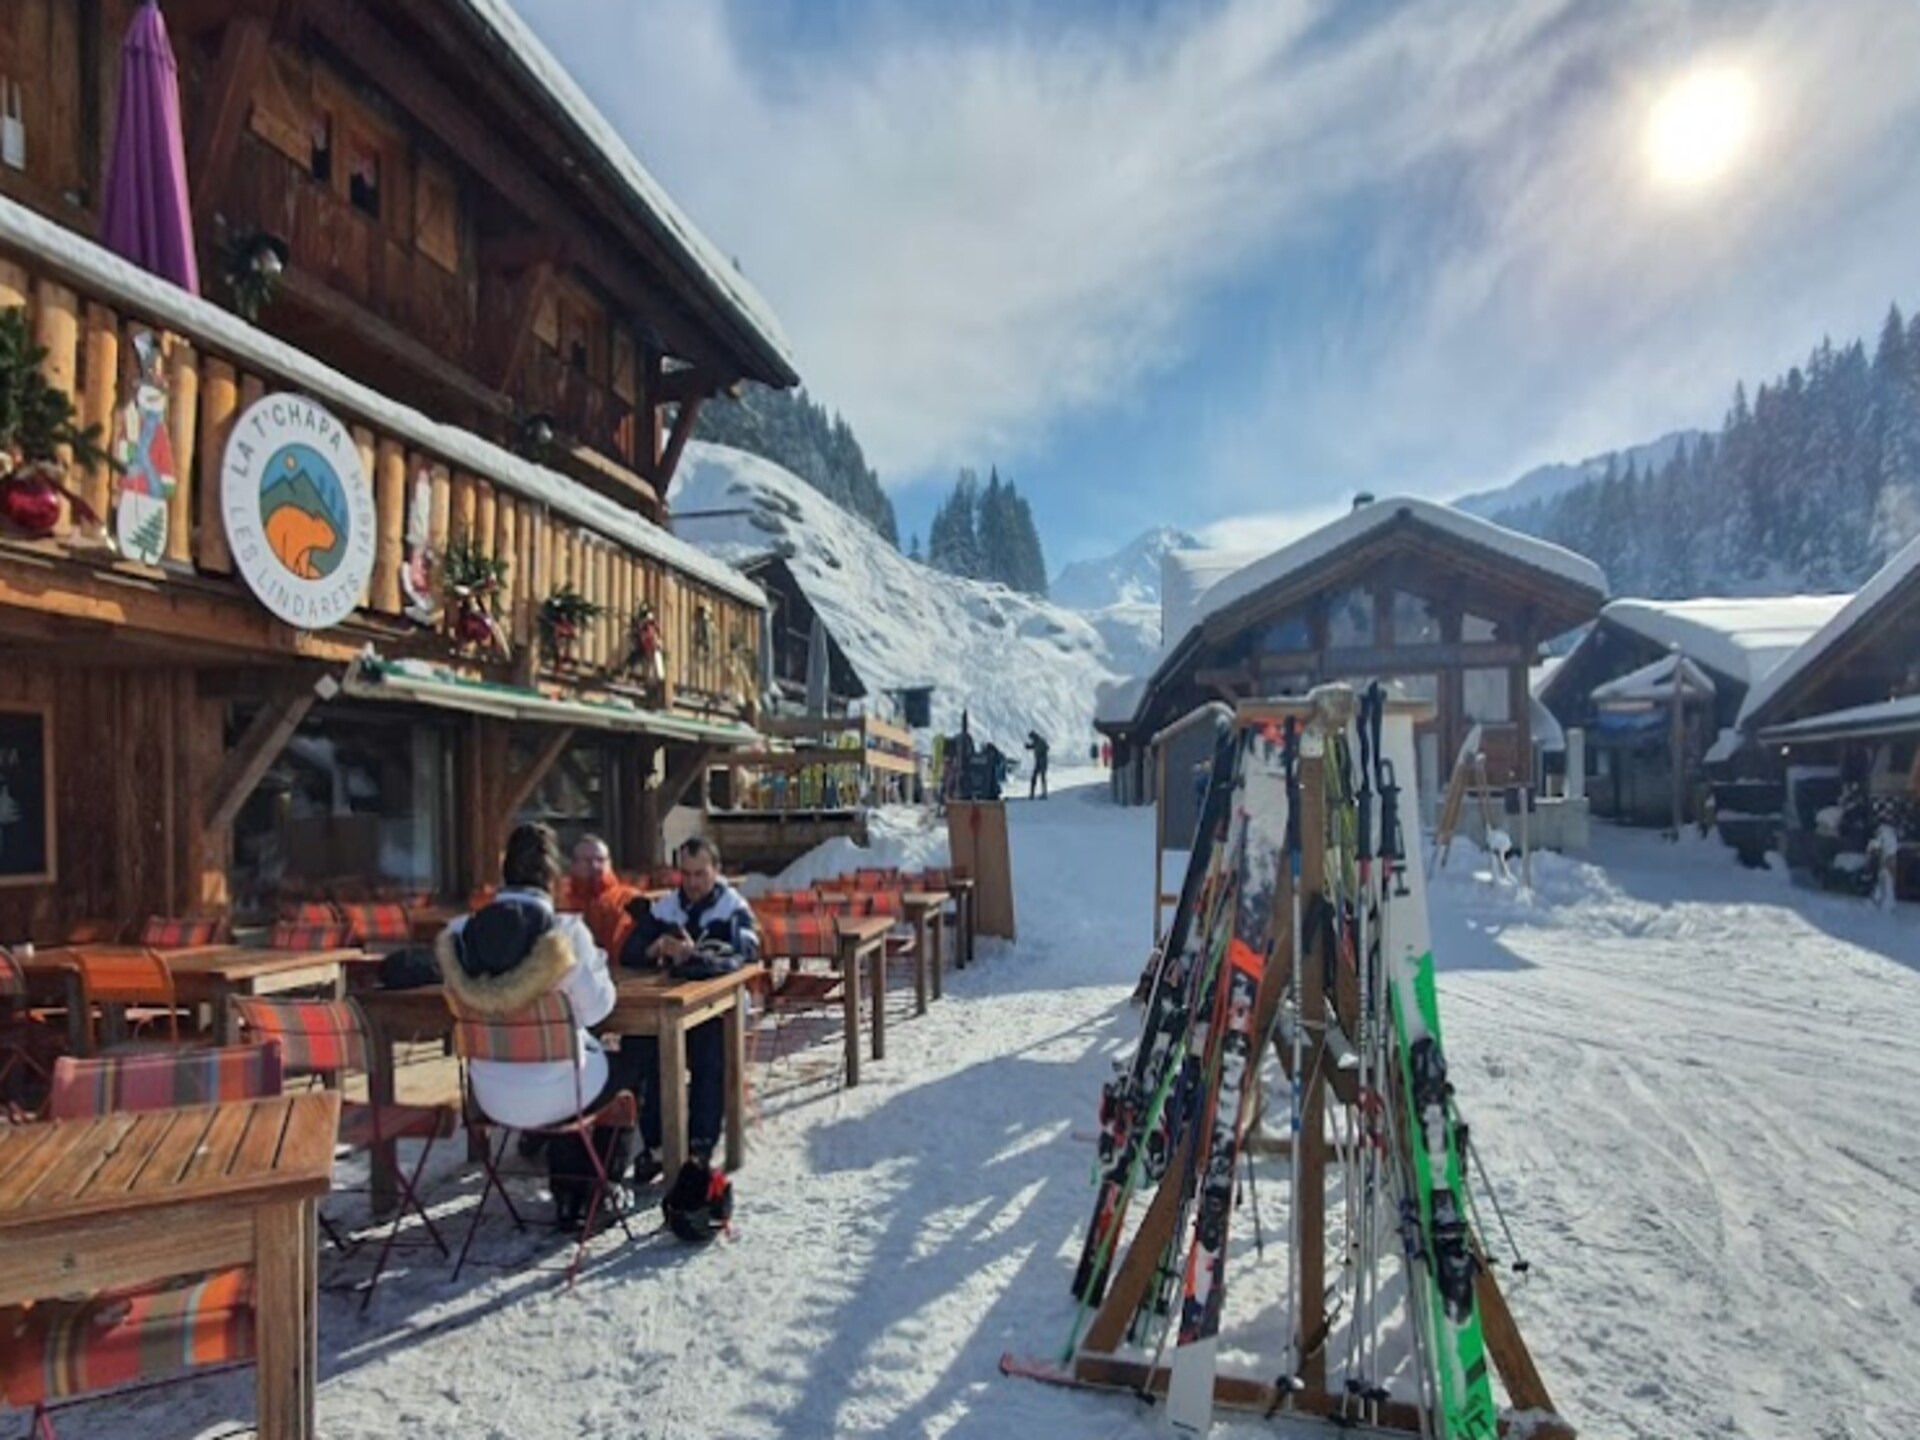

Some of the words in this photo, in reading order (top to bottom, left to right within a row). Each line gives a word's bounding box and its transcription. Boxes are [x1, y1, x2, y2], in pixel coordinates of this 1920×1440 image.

[231, 438, 255, 479] LA
[251, 402, 342, 453] T'CHAPA
[230, 506, 258, 563] LES
[256, 572, 361, 619] LINDARETS
